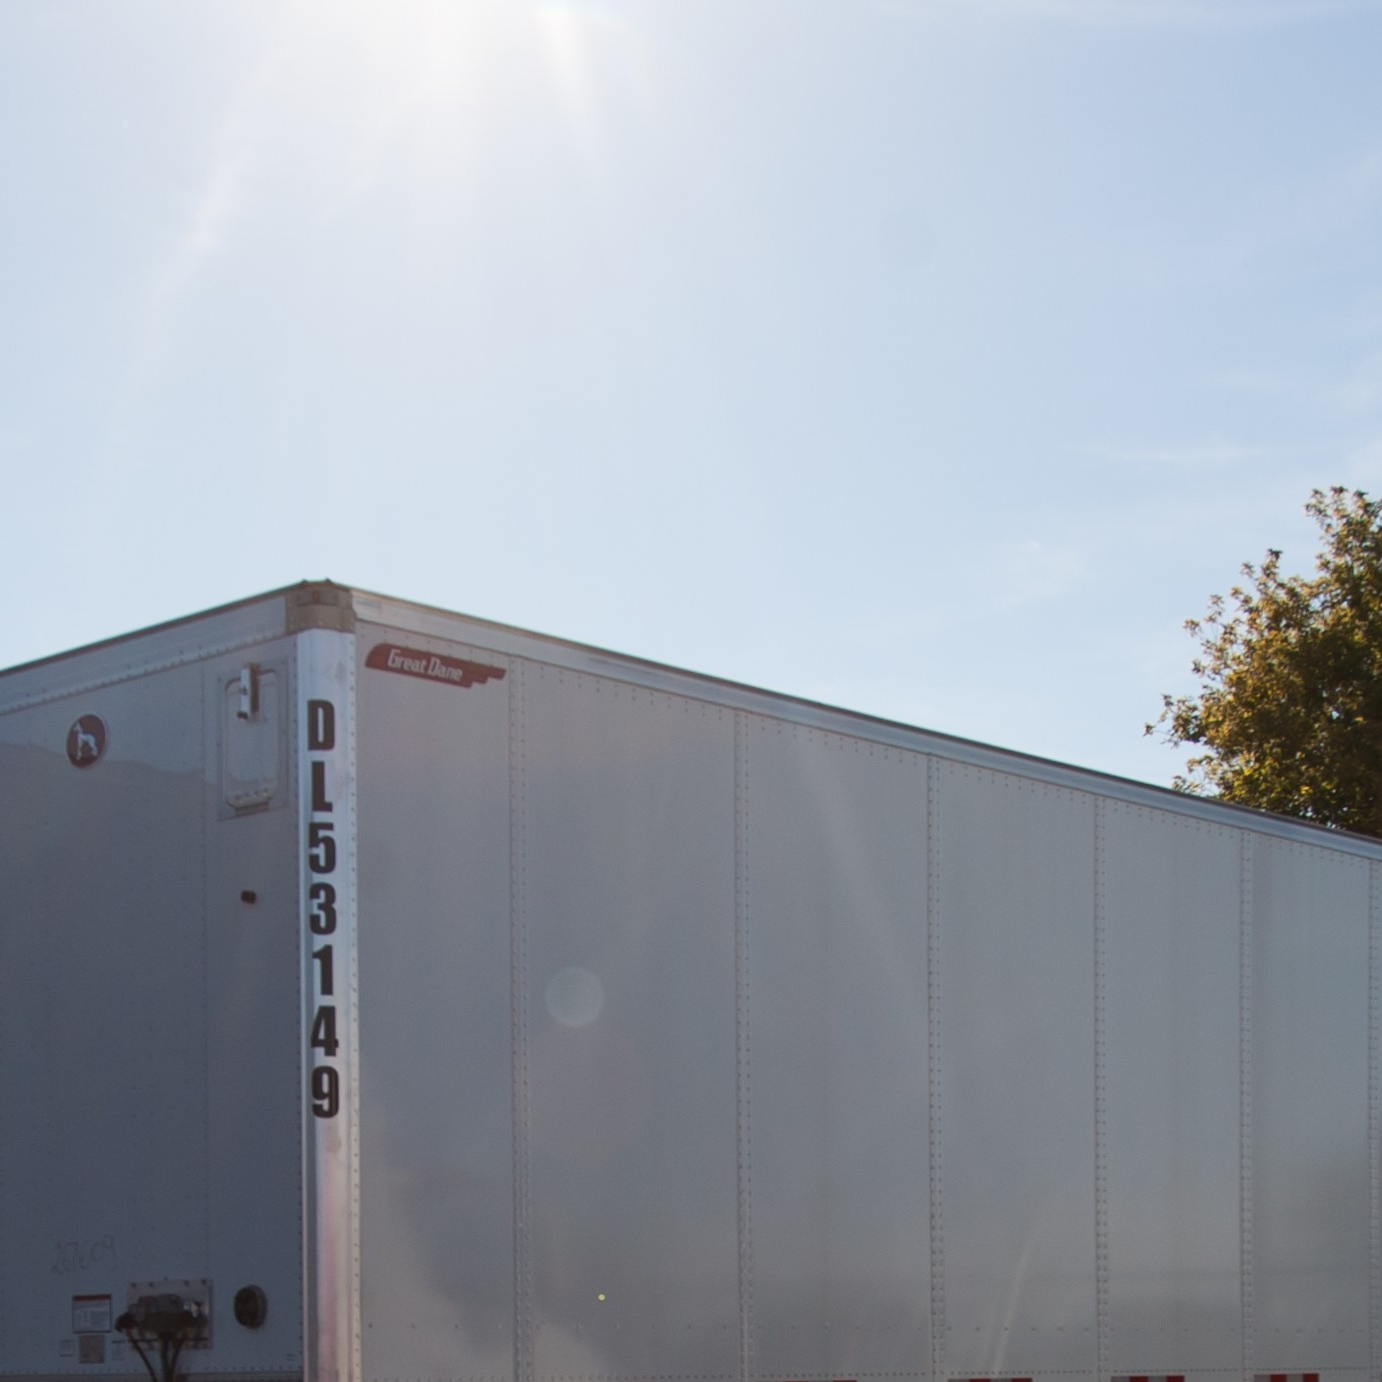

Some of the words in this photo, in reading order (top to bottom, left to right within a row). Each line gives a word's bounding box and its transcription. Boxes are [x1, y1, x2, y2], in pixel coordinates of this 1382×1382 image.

[387, 648, 427, 674] Great
[426, 656, 463, 681] Dane
[307, 699, 339, 1119] DL53149
